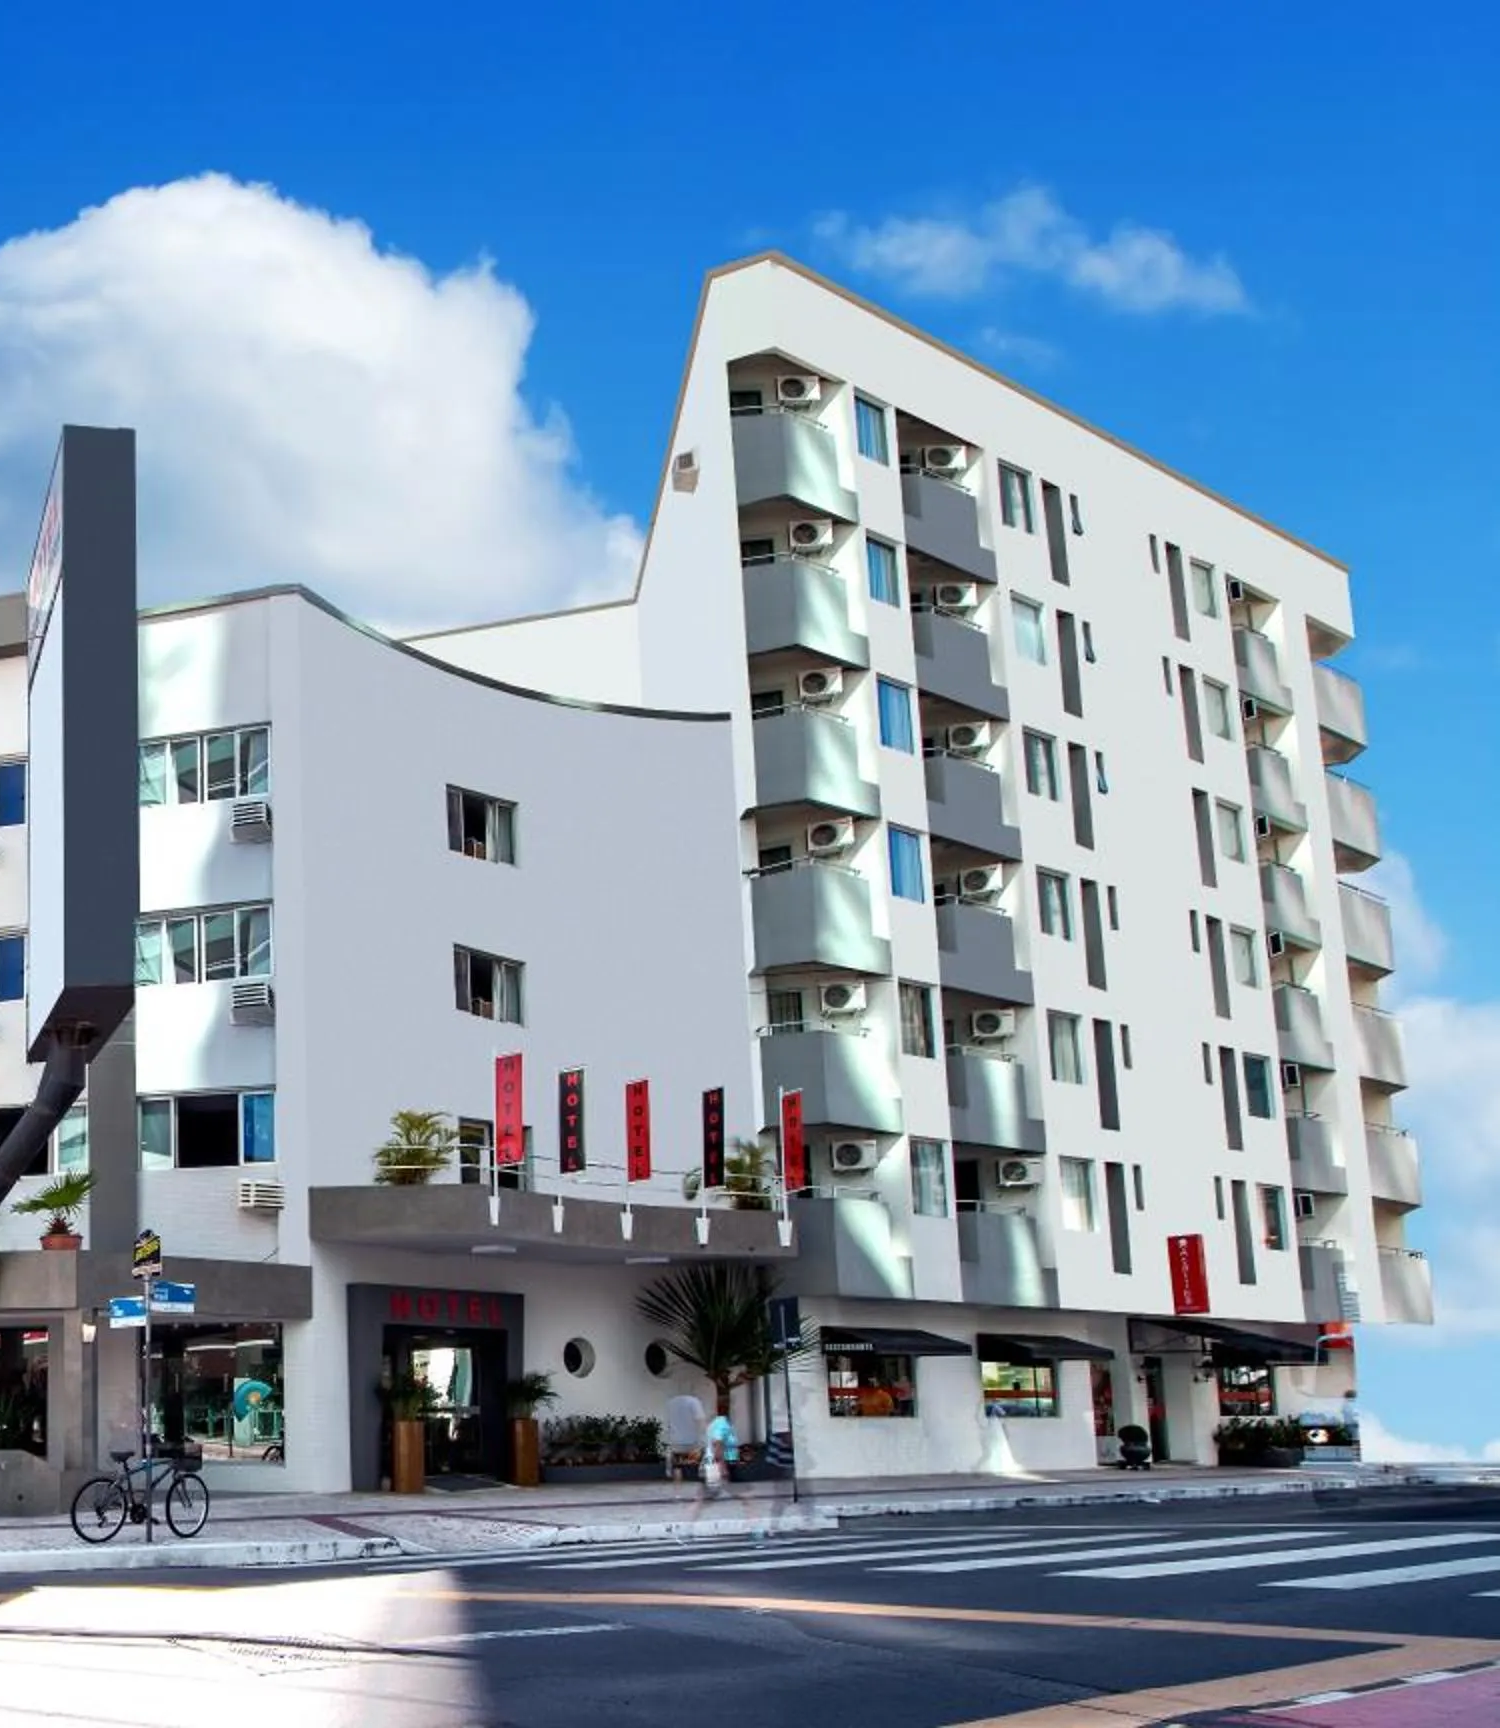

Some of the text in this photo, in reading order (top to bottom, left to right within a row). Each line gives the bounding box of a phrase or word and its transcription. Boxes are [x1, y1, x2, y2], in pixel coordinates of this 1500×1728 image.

[566, 1073, 579, 1170] HOTEL
[632, 1083, 644, 1180] HOTEL
[708, 1092, 720, 1185] HOTEL
[389, 1291, 503, 1326] HOTEL
